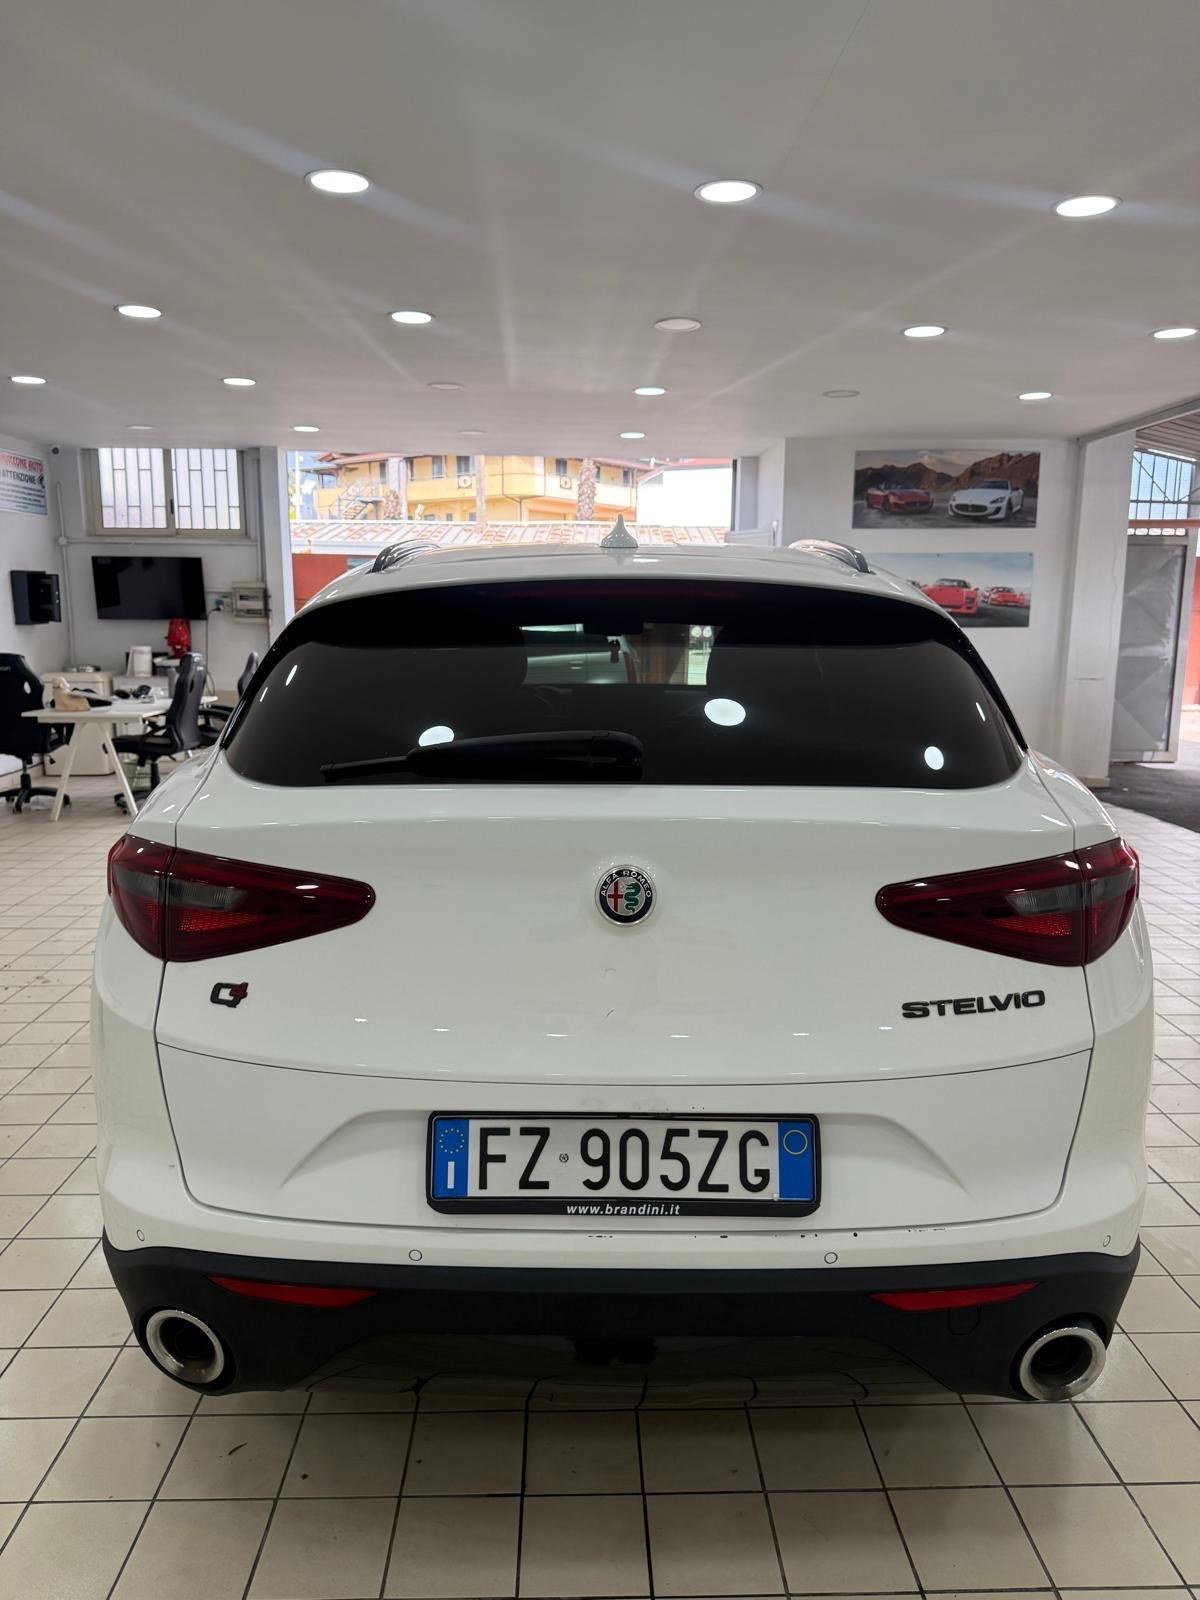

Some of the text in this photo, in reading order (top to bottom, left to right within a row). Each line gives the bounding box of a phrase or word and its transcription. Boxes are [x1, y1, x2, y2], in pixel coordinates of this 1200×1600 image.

[2, 469, 36, 485] ATTENZIONE
[600, 870, 652, 898] ALFA ROMEO
[901, 989, 1046, 1019] STELVIO
[478, 1127, 771, 1193] FZ 905ZG
[566, 1203, 681, 1216] www.brandini.it
